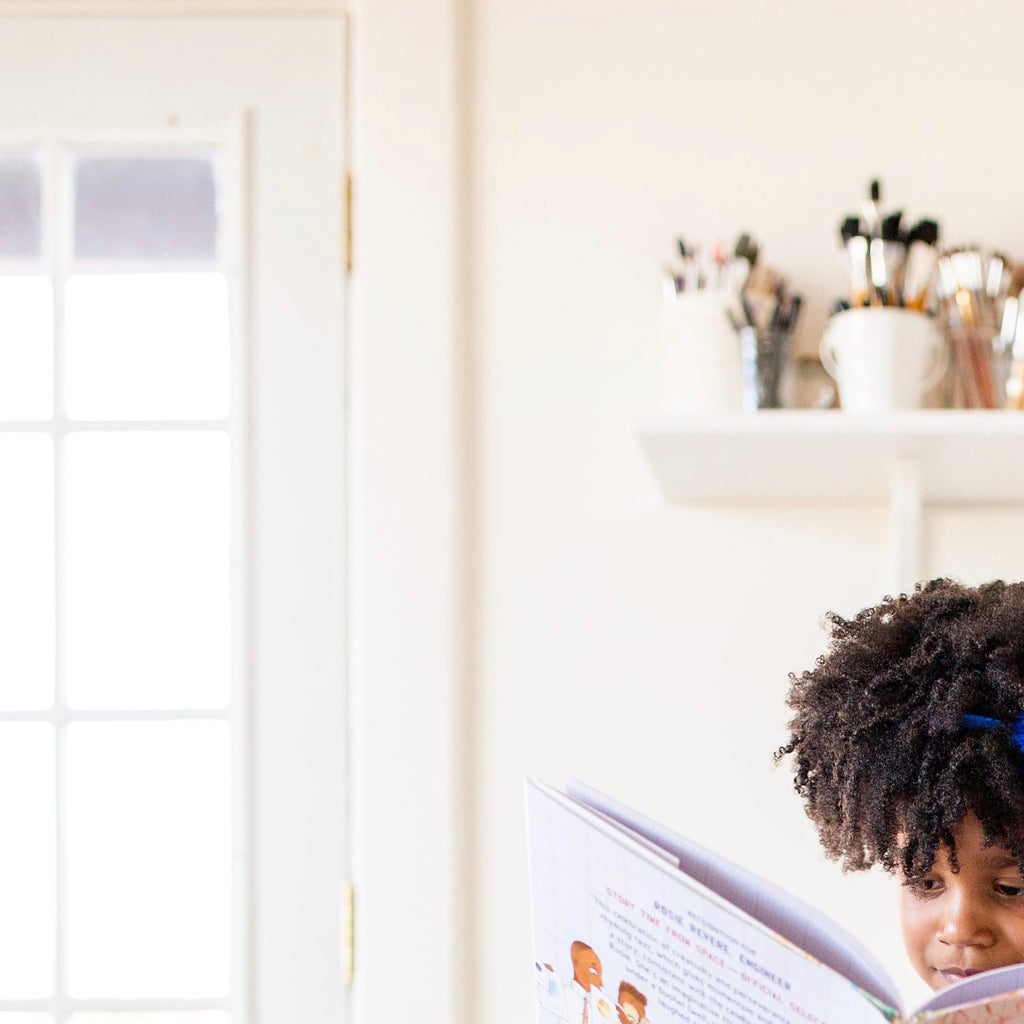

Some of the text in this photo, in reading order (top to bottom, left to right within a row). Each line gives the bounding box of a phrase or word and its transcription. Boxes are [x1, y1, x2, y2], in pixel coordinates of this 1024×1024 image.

[606, 885, 634, 910] STORY
[640, 908, 658, 927] TIME
[665, 925, 690, 946] FROM
[654, 900, 682, 925] ROSIE
[739, 953, 791, 990] ENGINEER
